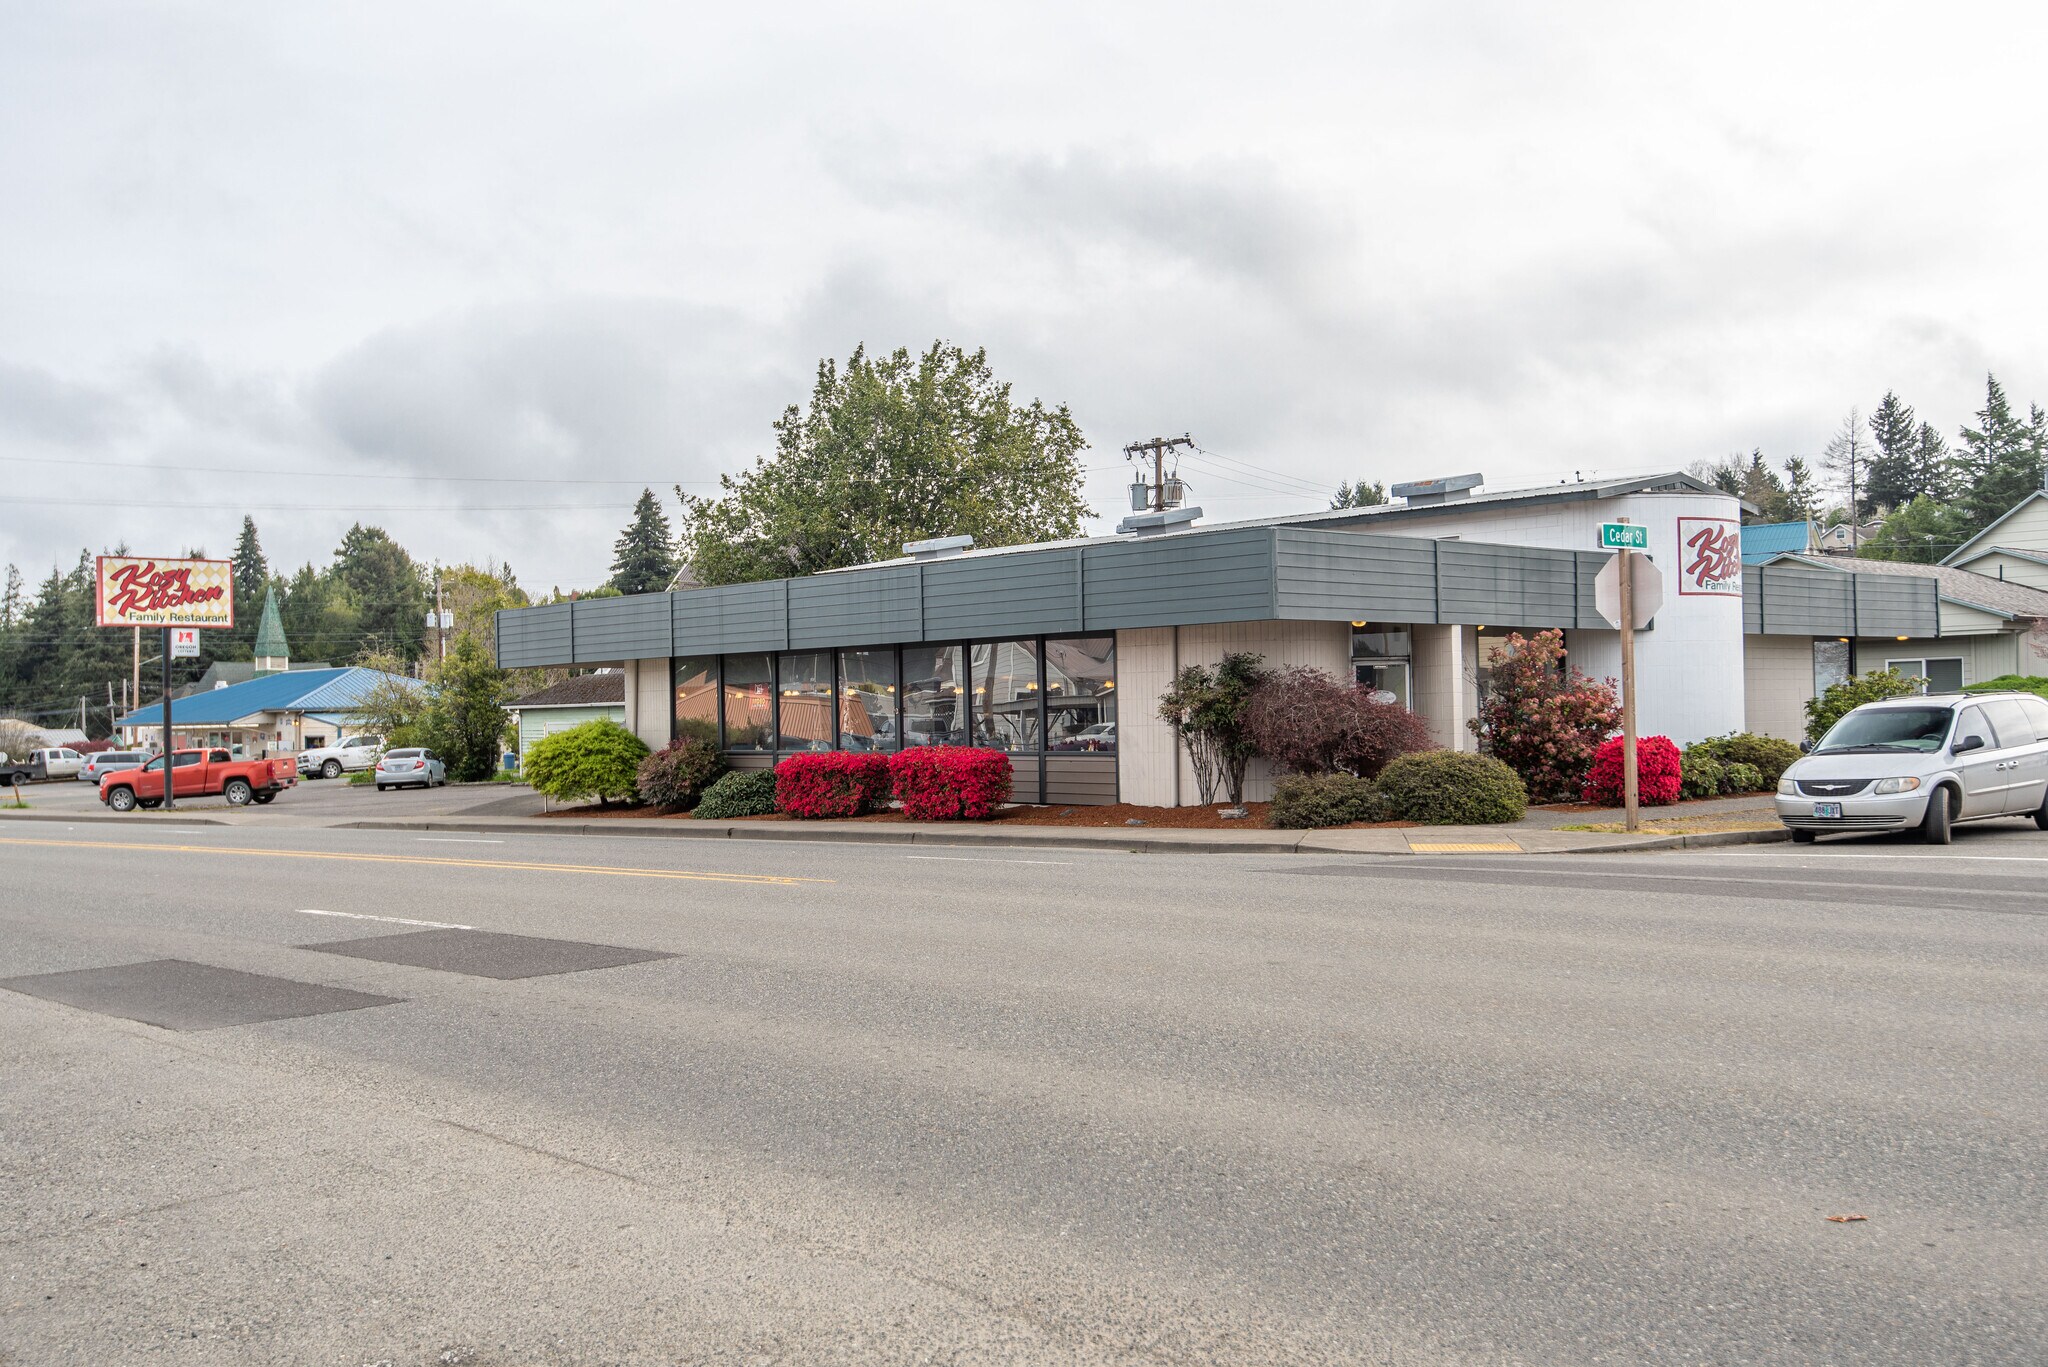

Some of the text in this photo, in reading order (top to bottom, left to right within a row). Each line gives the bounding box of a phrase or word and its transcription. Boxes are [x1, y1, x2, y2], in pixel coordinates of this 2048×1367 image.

[1609, 528, 1643, 544] Cedar St
[109, 561, 192, 592] Kozy
[1705, 580, 1731, 592] Family
[108, 585, 225, 617] Kitchen
[129, 612, 228, 623] Family Restaurant
